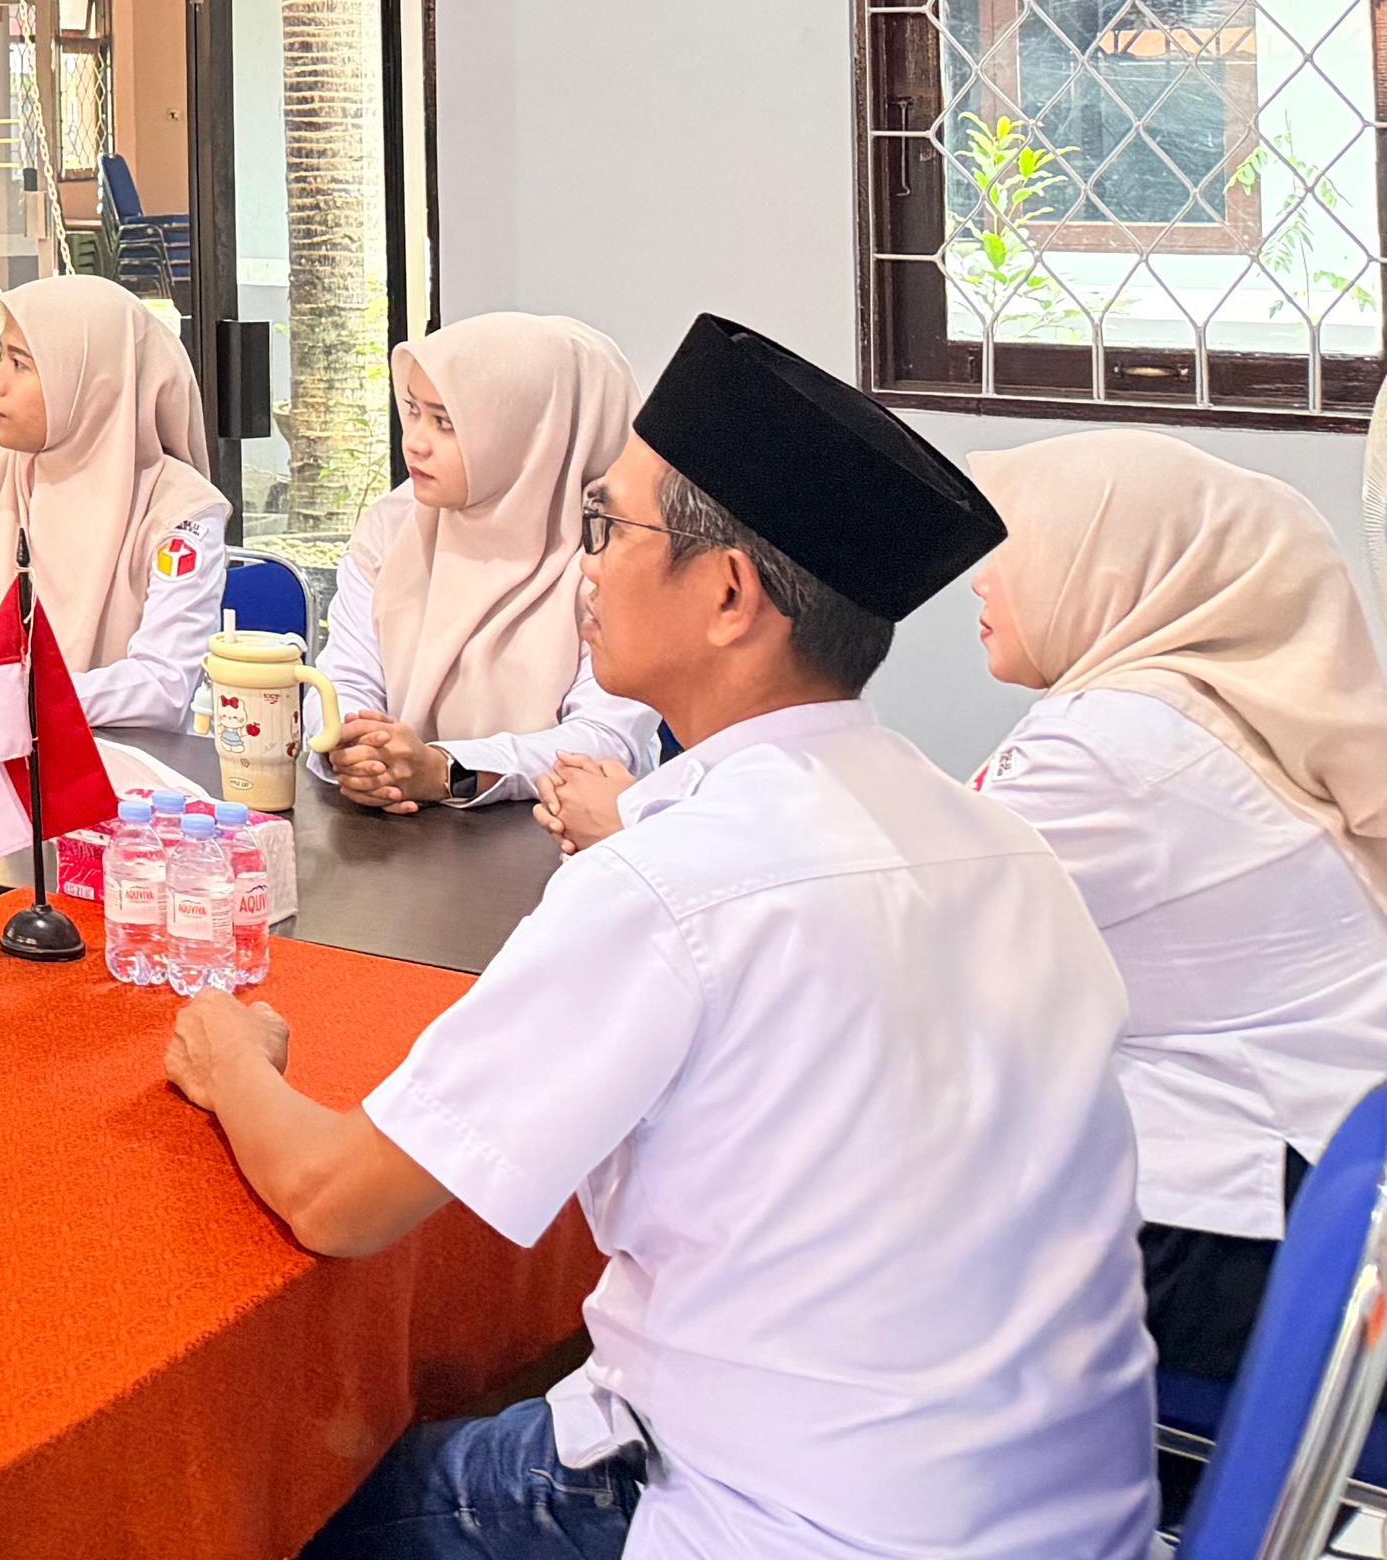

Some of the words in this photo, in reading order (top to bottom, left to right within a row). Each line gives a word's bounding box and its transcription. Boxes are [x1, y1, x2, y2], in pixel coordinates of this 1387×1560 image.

[125, 889, 155, 901] AQUVIVA
[239, 892, 266, 913] AQUV
[178, 902, 208, 917] AQUVIVA
